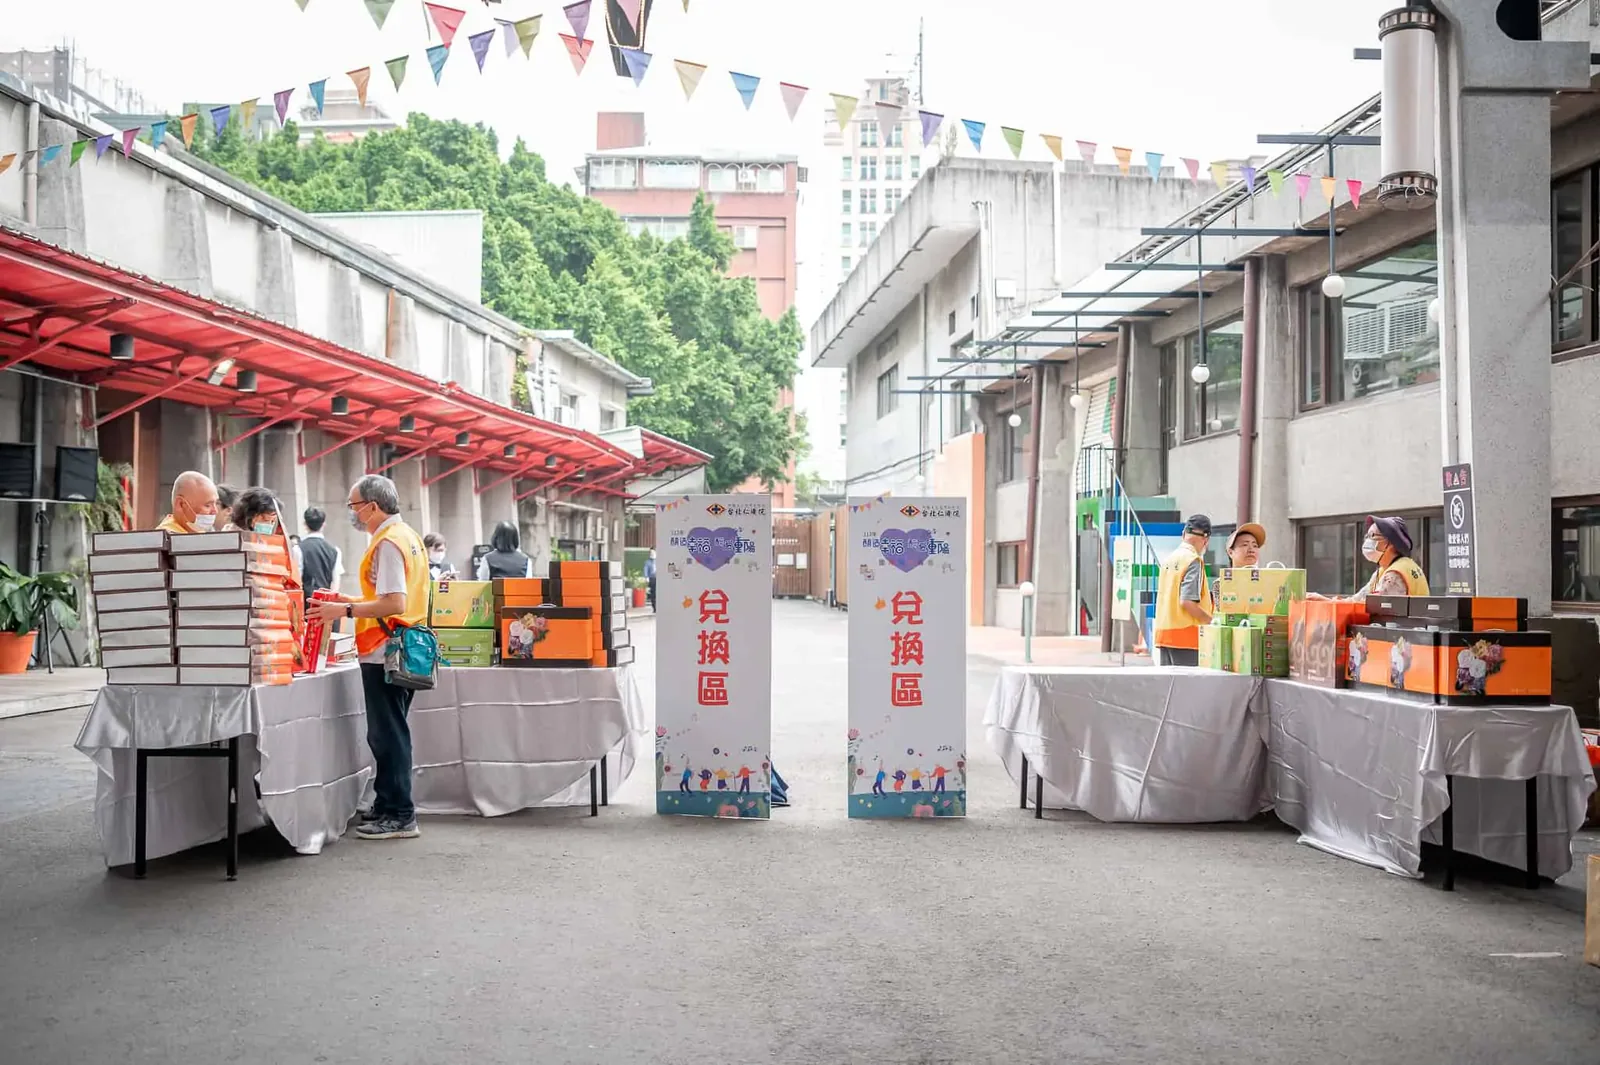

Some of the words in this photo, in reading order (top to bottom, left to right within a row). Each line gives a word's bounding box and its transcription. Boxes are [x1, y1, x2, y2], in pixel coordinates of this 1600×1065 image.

[697, 589, 730, 707] 兌換區
[890, 590, 924, 707] 兌換區
